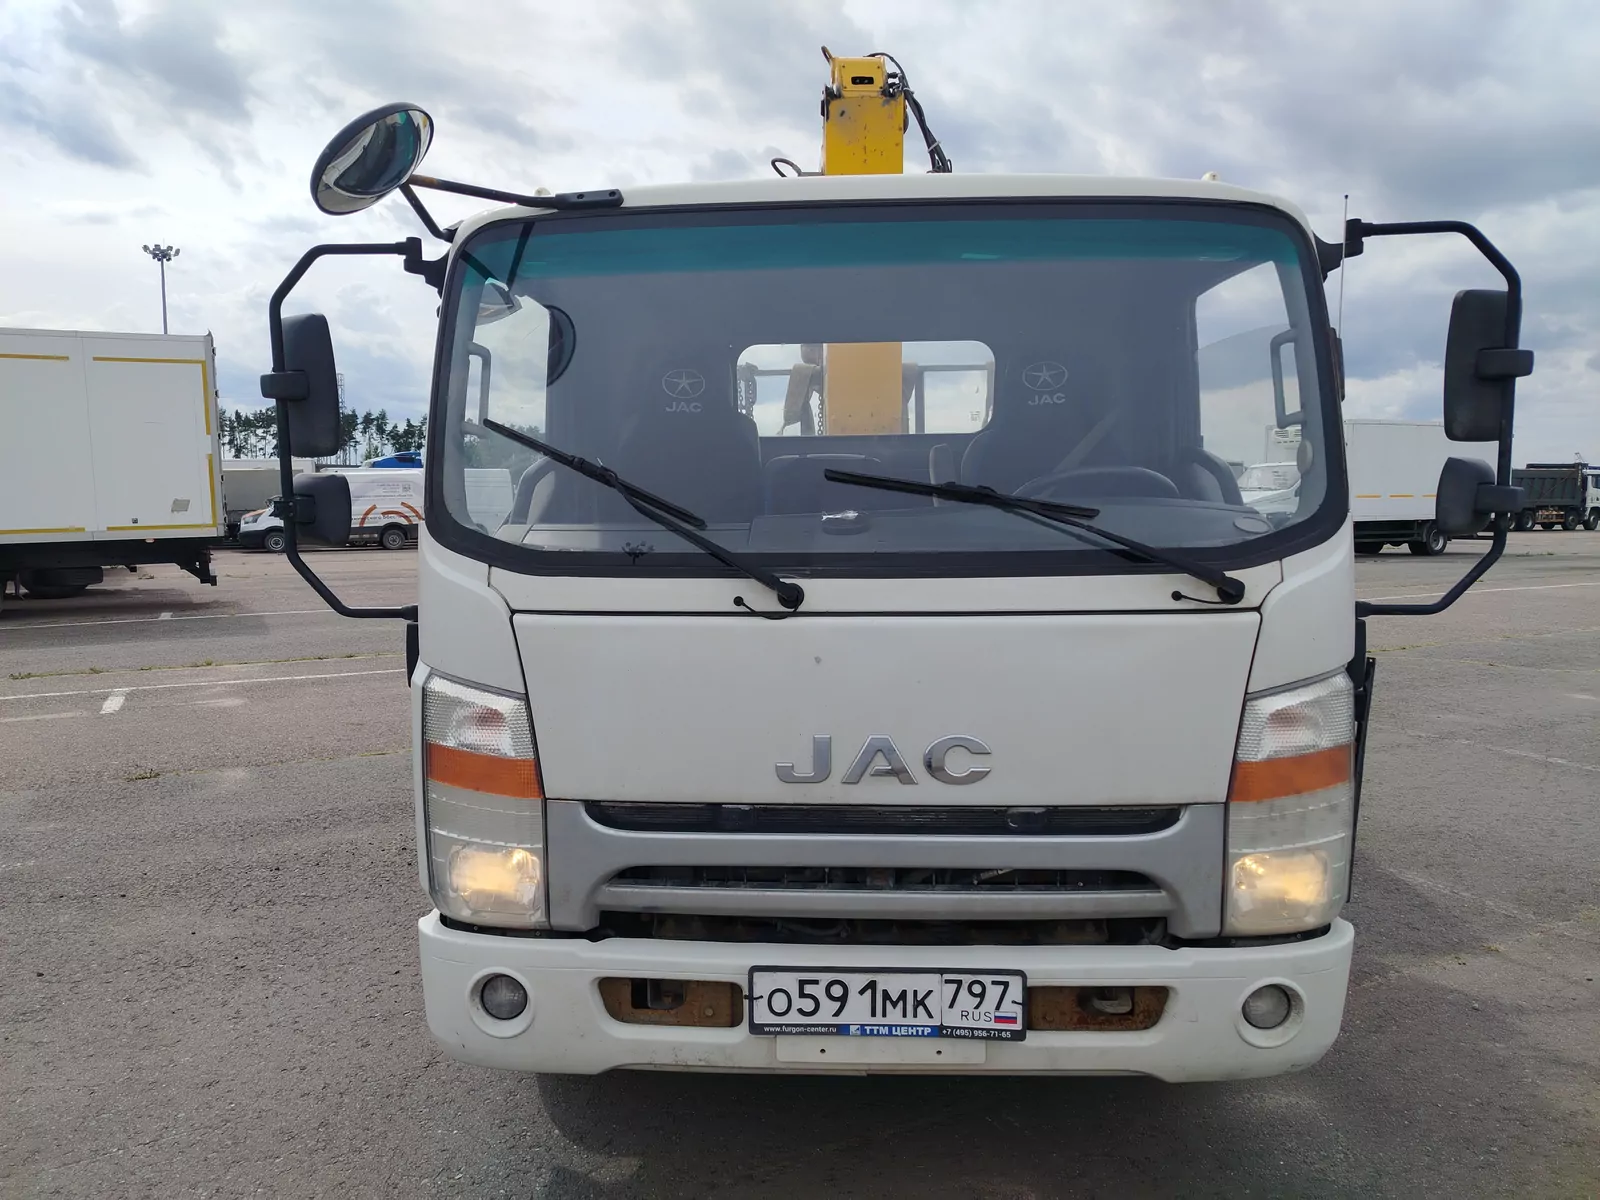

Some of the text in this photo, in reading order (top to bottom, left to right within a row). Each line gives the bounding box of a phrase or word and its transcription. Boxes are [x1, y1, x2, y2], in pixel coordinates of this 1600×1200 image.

[1028, 392, 1066, 405] JAC
[665, 401, 703, 412] JAC
[775, 734, 992, 785] JAC
[944, 978, 1010, 1011] 797
[960, 1010, 992, 1022] RUS
[763, 1025, 837, 1034] www.furgon-center.ru
[892, 1026, 932, 1036] ЦЕНТР
[953, 1029, 972, 1037] (495)
[973, 1030, 1011, 1038] 956-71-65
